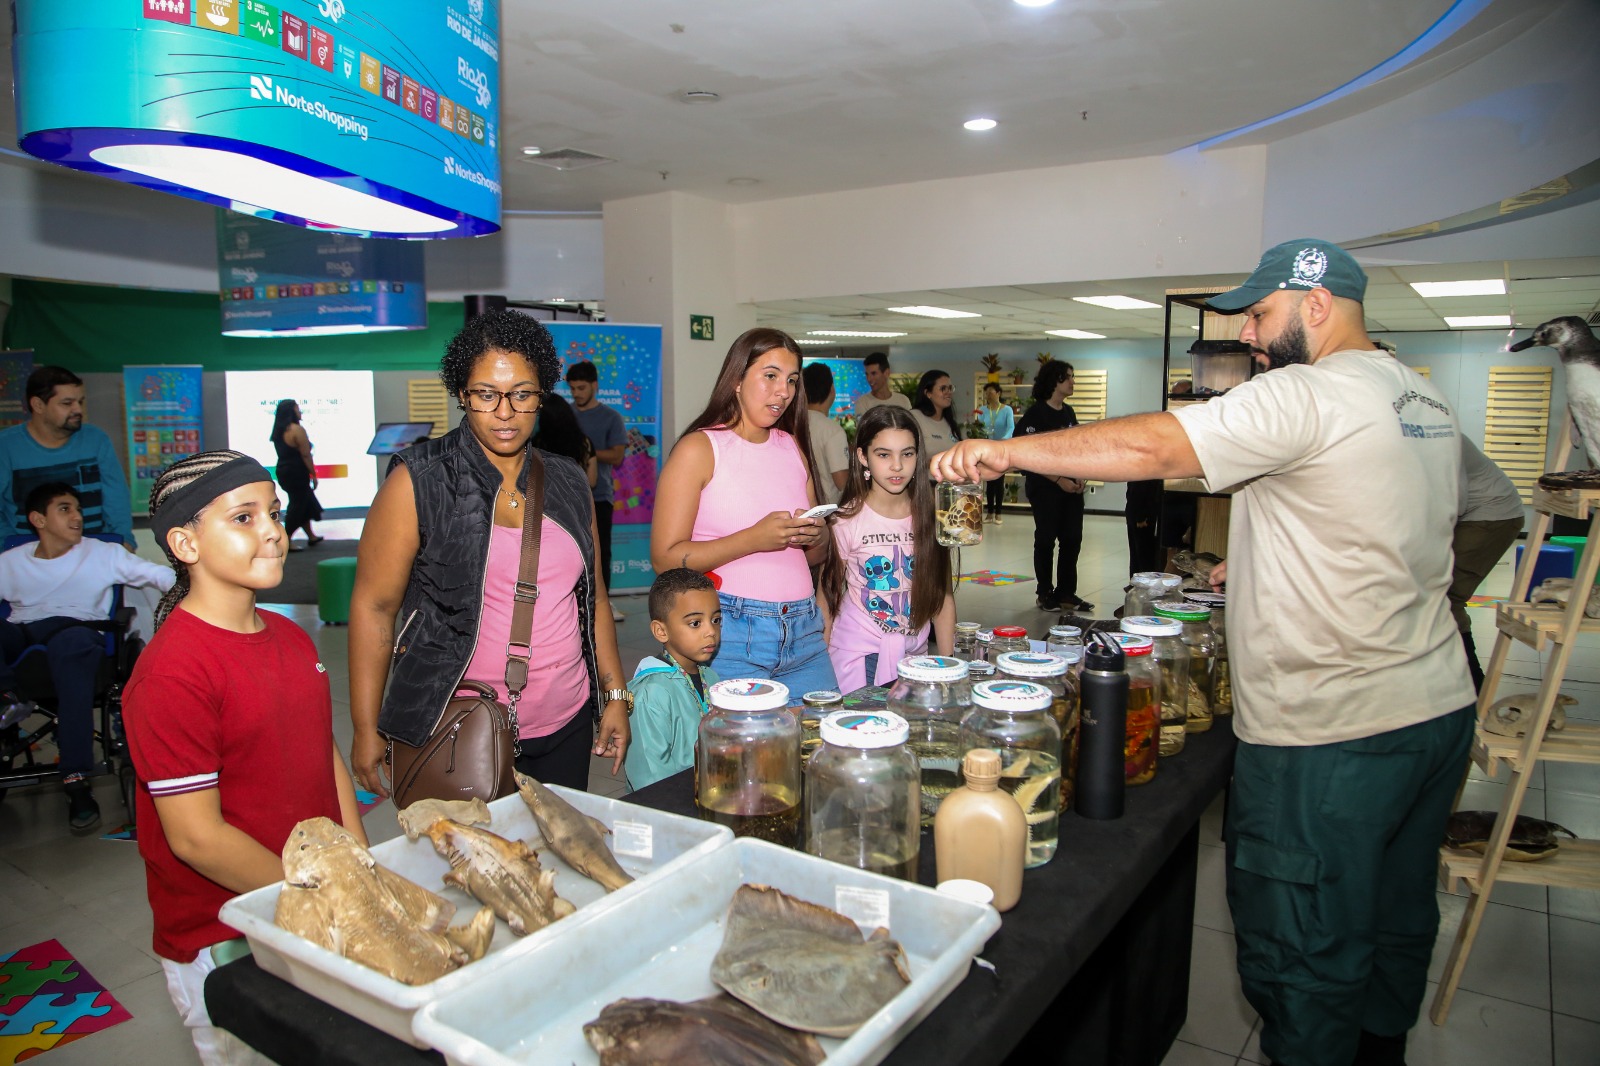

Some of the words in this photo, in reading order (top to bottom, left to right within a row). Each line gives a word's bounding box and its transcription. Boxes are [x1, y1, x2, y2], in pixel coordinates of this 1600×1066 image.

[276, 84, 368, 141] NorteShopping
[862, 533, 901, 544] STITCH
[904, 532, 914, 542] IS
